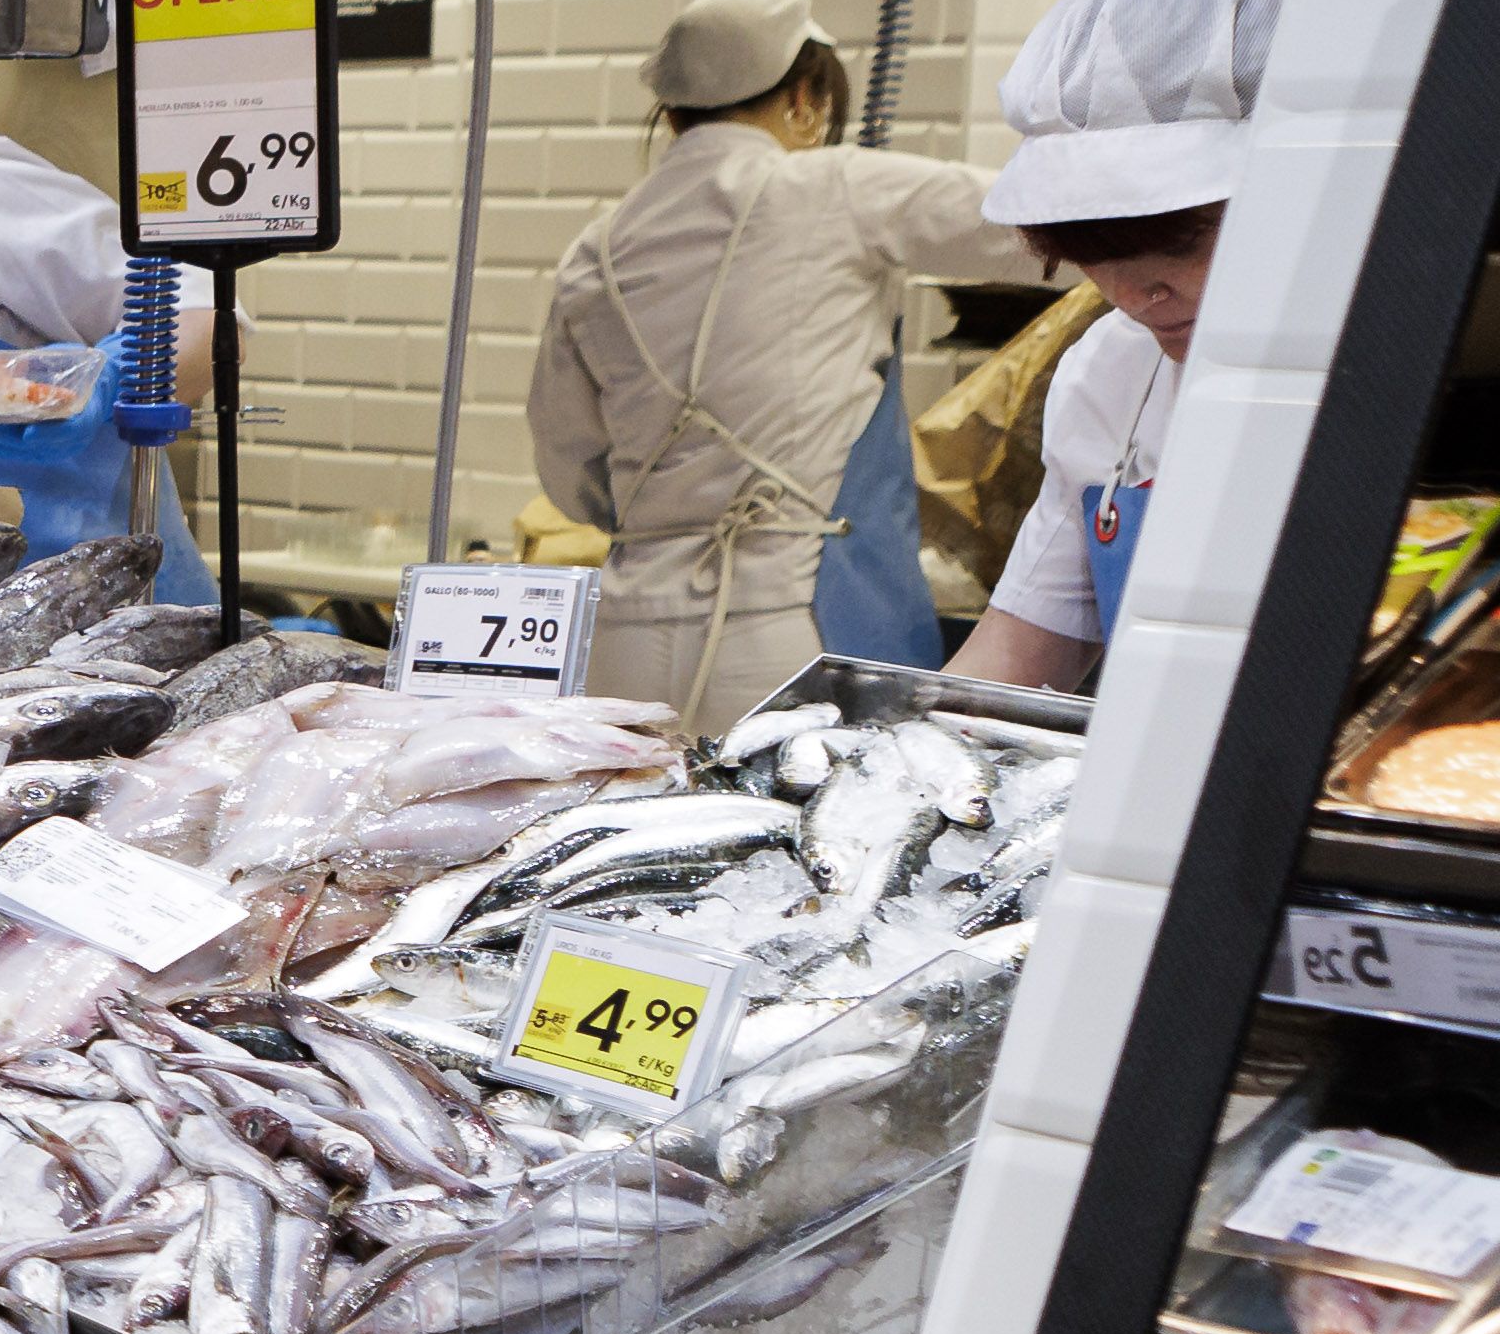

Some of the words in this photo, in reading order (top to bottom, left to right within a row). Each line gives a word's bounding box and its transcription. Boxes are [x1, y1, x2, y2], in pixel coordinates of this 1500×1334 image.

[196, 131, 315, 207] 6,99
[272, 193, 311, 211] €/Kg
[265, 218, 305, 231] 22-Abr
[424, 586, 451, 595] GALLO
[479, 615, 559, 658] 7,90
[575, 988, 698, 1054] 4,99
[638, 1055, 675, 1077] €/Kg
